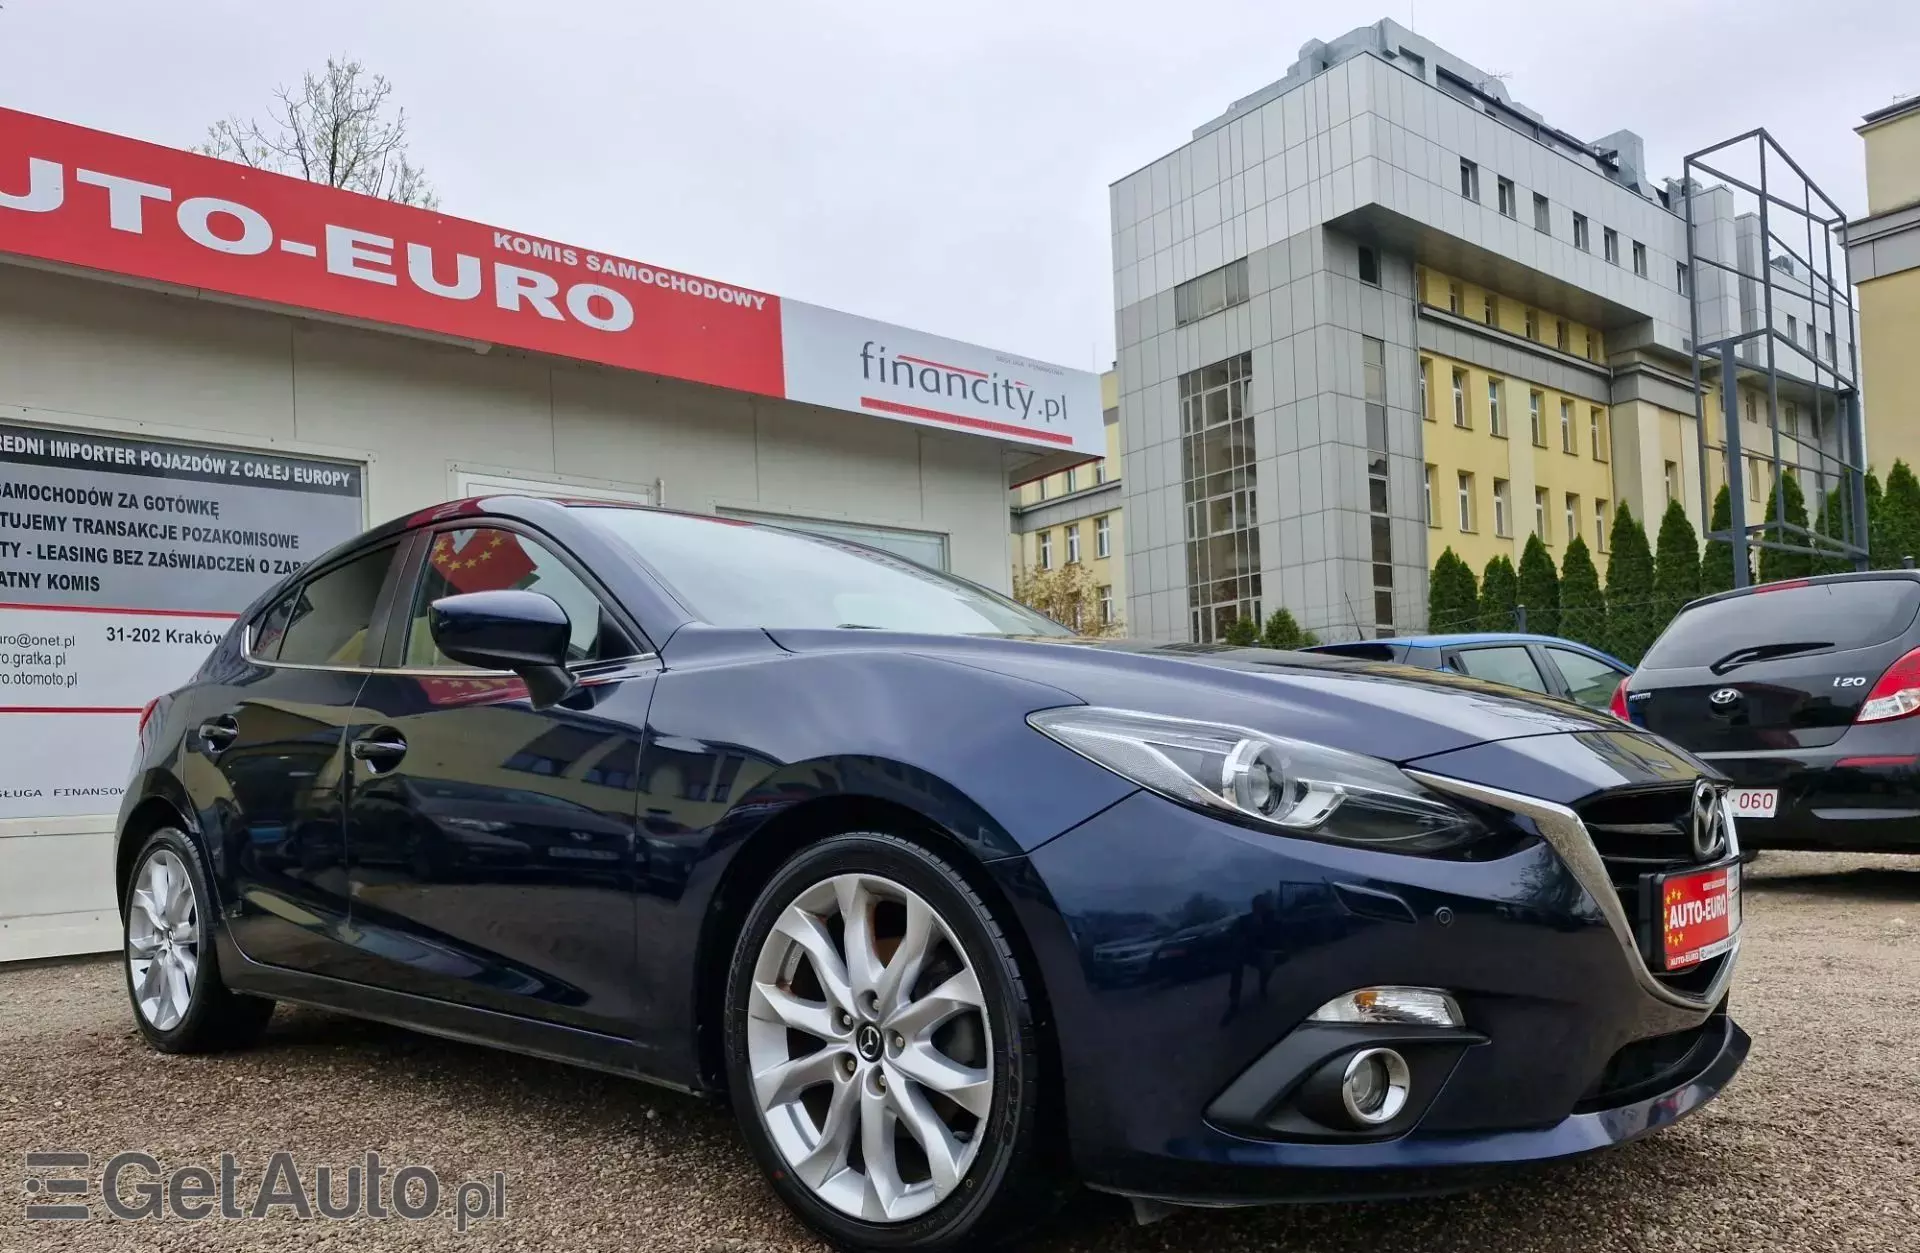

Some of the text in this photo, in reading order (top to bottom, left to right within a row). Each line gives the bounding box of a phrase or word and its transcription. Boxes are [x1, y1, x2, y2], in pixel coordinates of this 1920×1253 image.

[494, 231, 767, 312] KOMIS SAMOCHODOWY
[859, 341, 1068, 423] financity.pl
[50, 440, 136, 466] IMPORTER
[141, 449, 226, 475] POJAZDÓW
[230, 460, 240, 476] Z
[244, 462, 290, 481] CAŁEJ
[294, 465, 350, 488] EUROPY
[0, 482, 220, 520] AMOCHODÓW ZA GOTÓWKĘ
[73, 517, 177, 541] TRANSAKCJE
[182, 525, 299, 549] POZAKOMISOWE
[37, 543, 108, 564] LEASING
[113, 549, 143, 566] BEZ
[148, 549, 255, 573] ZAŚWIADCZEŃ
[259, 559, 270, 574] O
[47, 573, 100, 592] KOMIS
[106, 626, 161, 644] 31-202
[0, 651, 66, 668] o.gratka.pl
[0, 671, 78, 688] o.otomoto.pl
[0, 788, 42, 798] ŁUGA
[1669, 893, 1726, 930] AUTO-EURO
